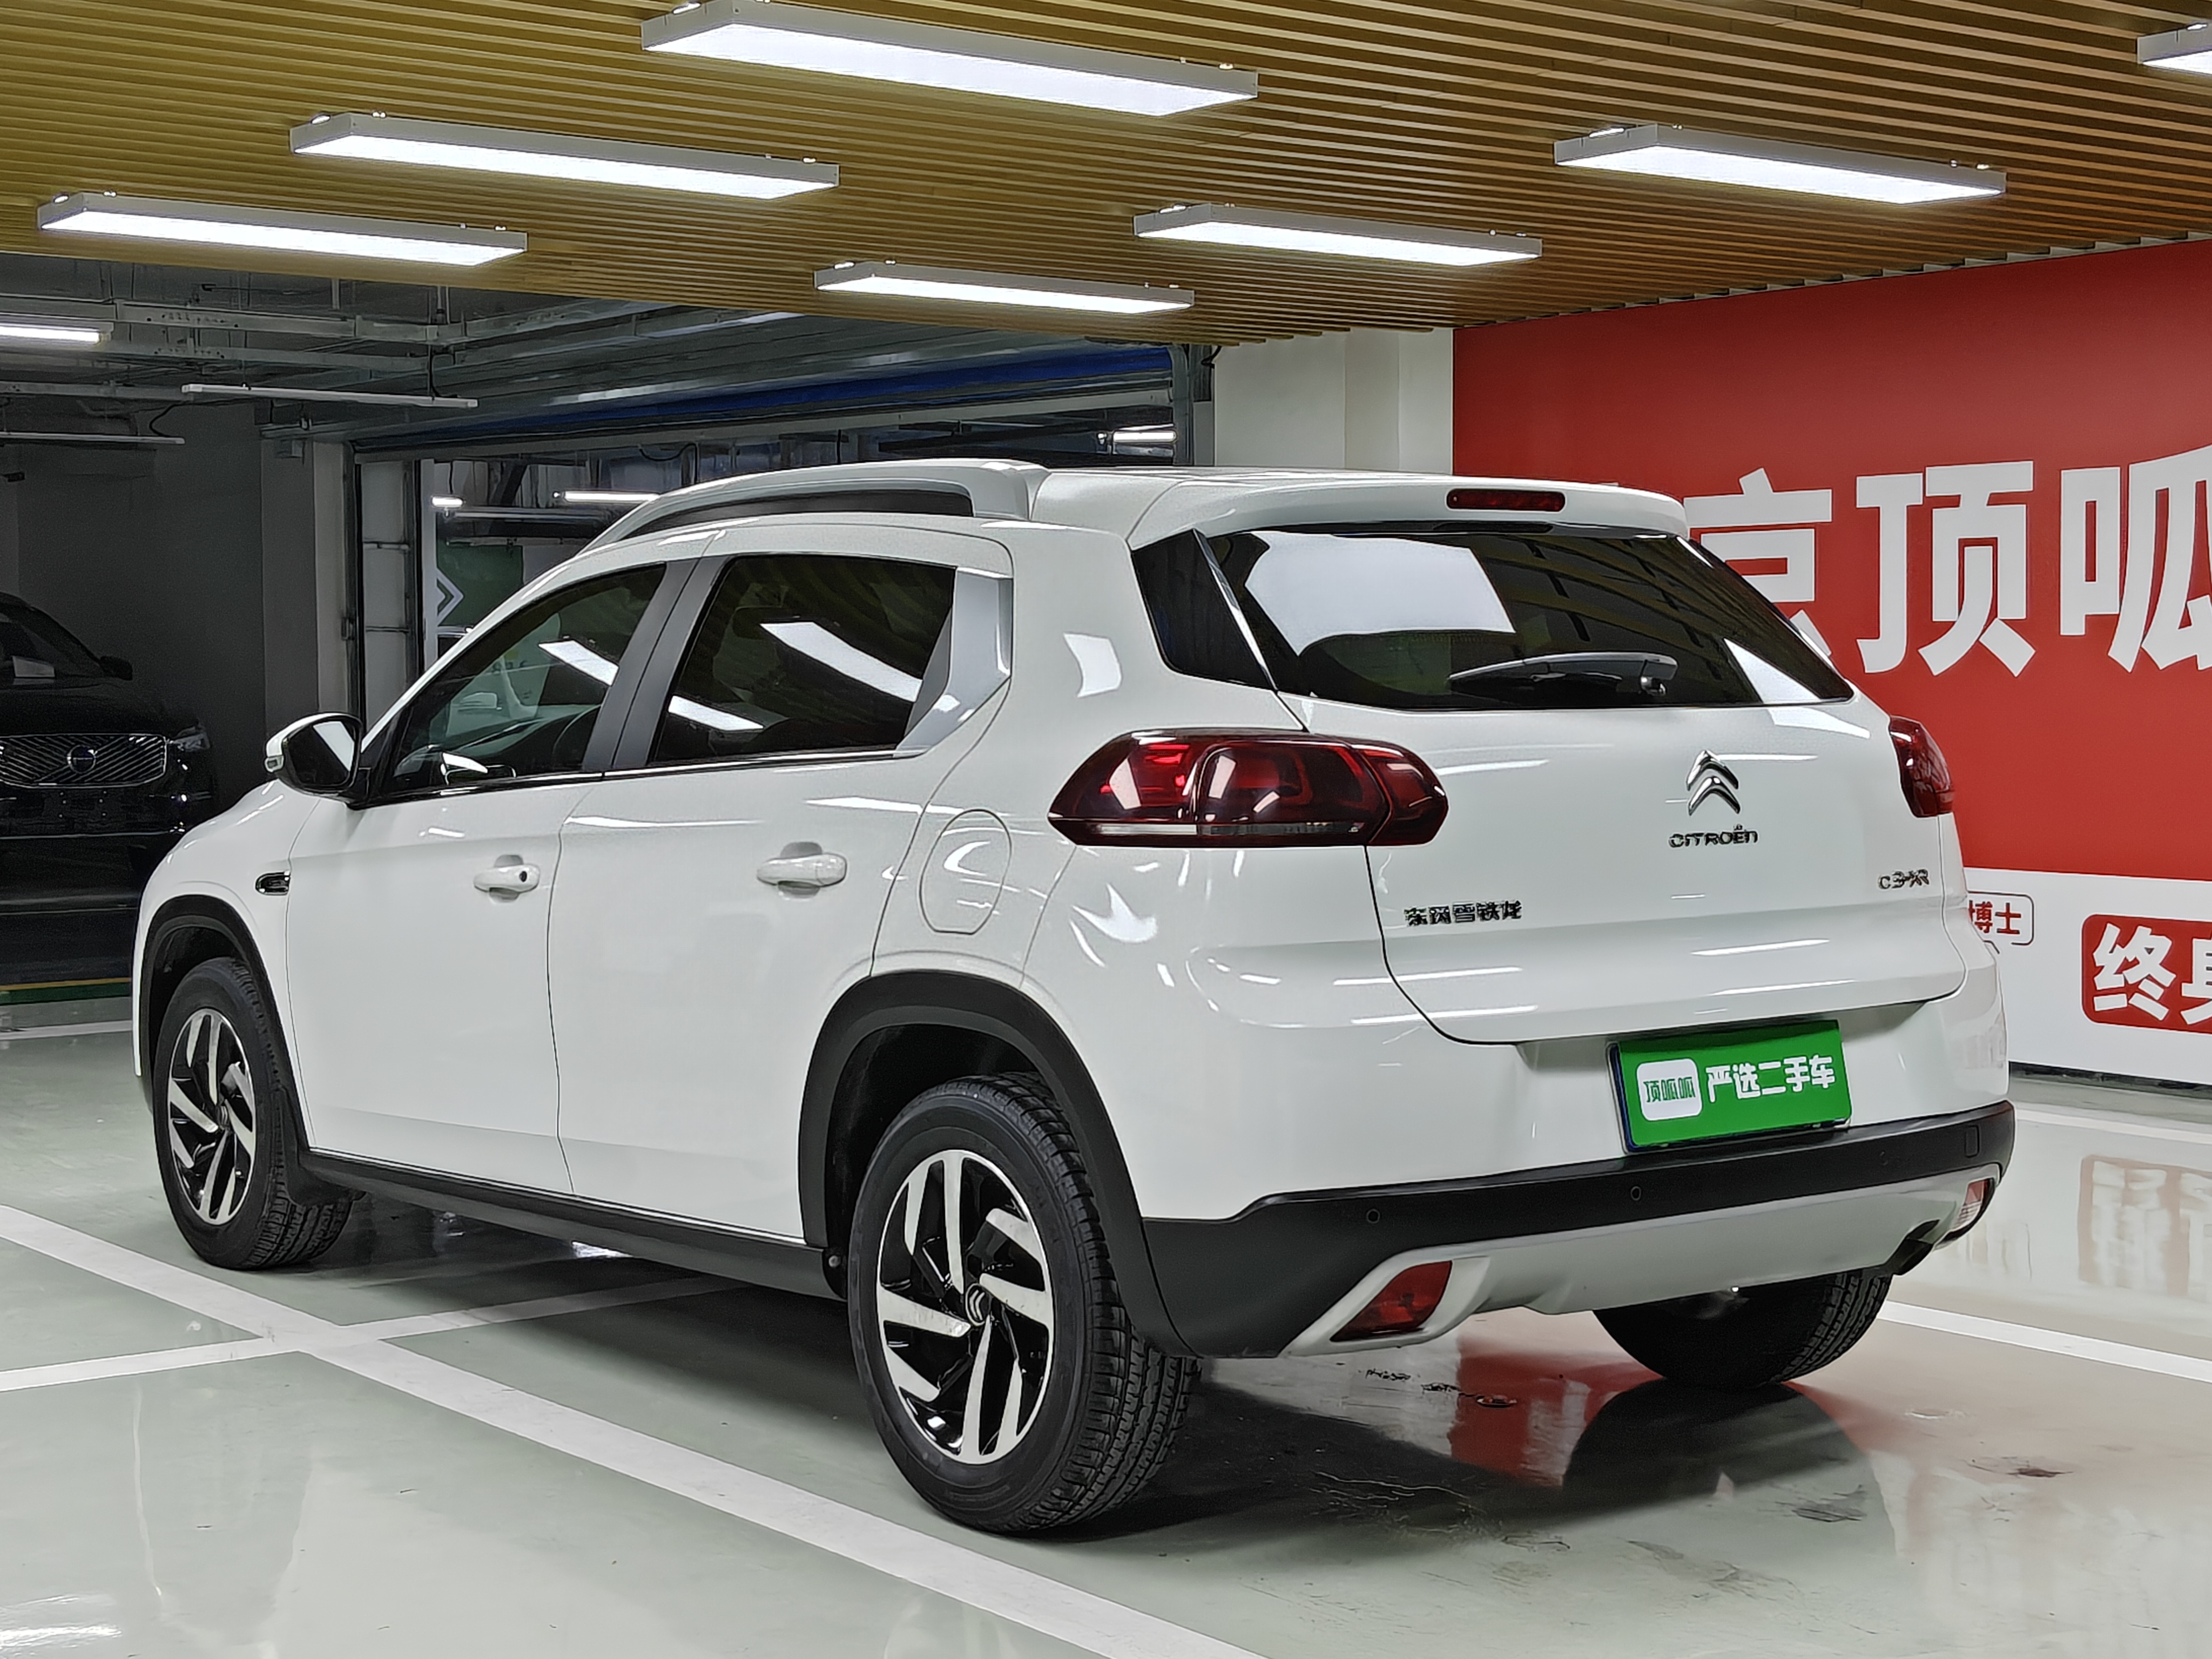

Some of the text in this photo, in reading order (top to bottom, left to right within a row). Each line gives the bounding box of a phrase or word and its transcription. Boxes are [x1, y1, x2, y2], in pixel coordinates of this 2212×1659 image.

[1404, 900, 1521, 926] 东风雪铁龙
[1705, 1055, 1835, 1103] 严选二手车
